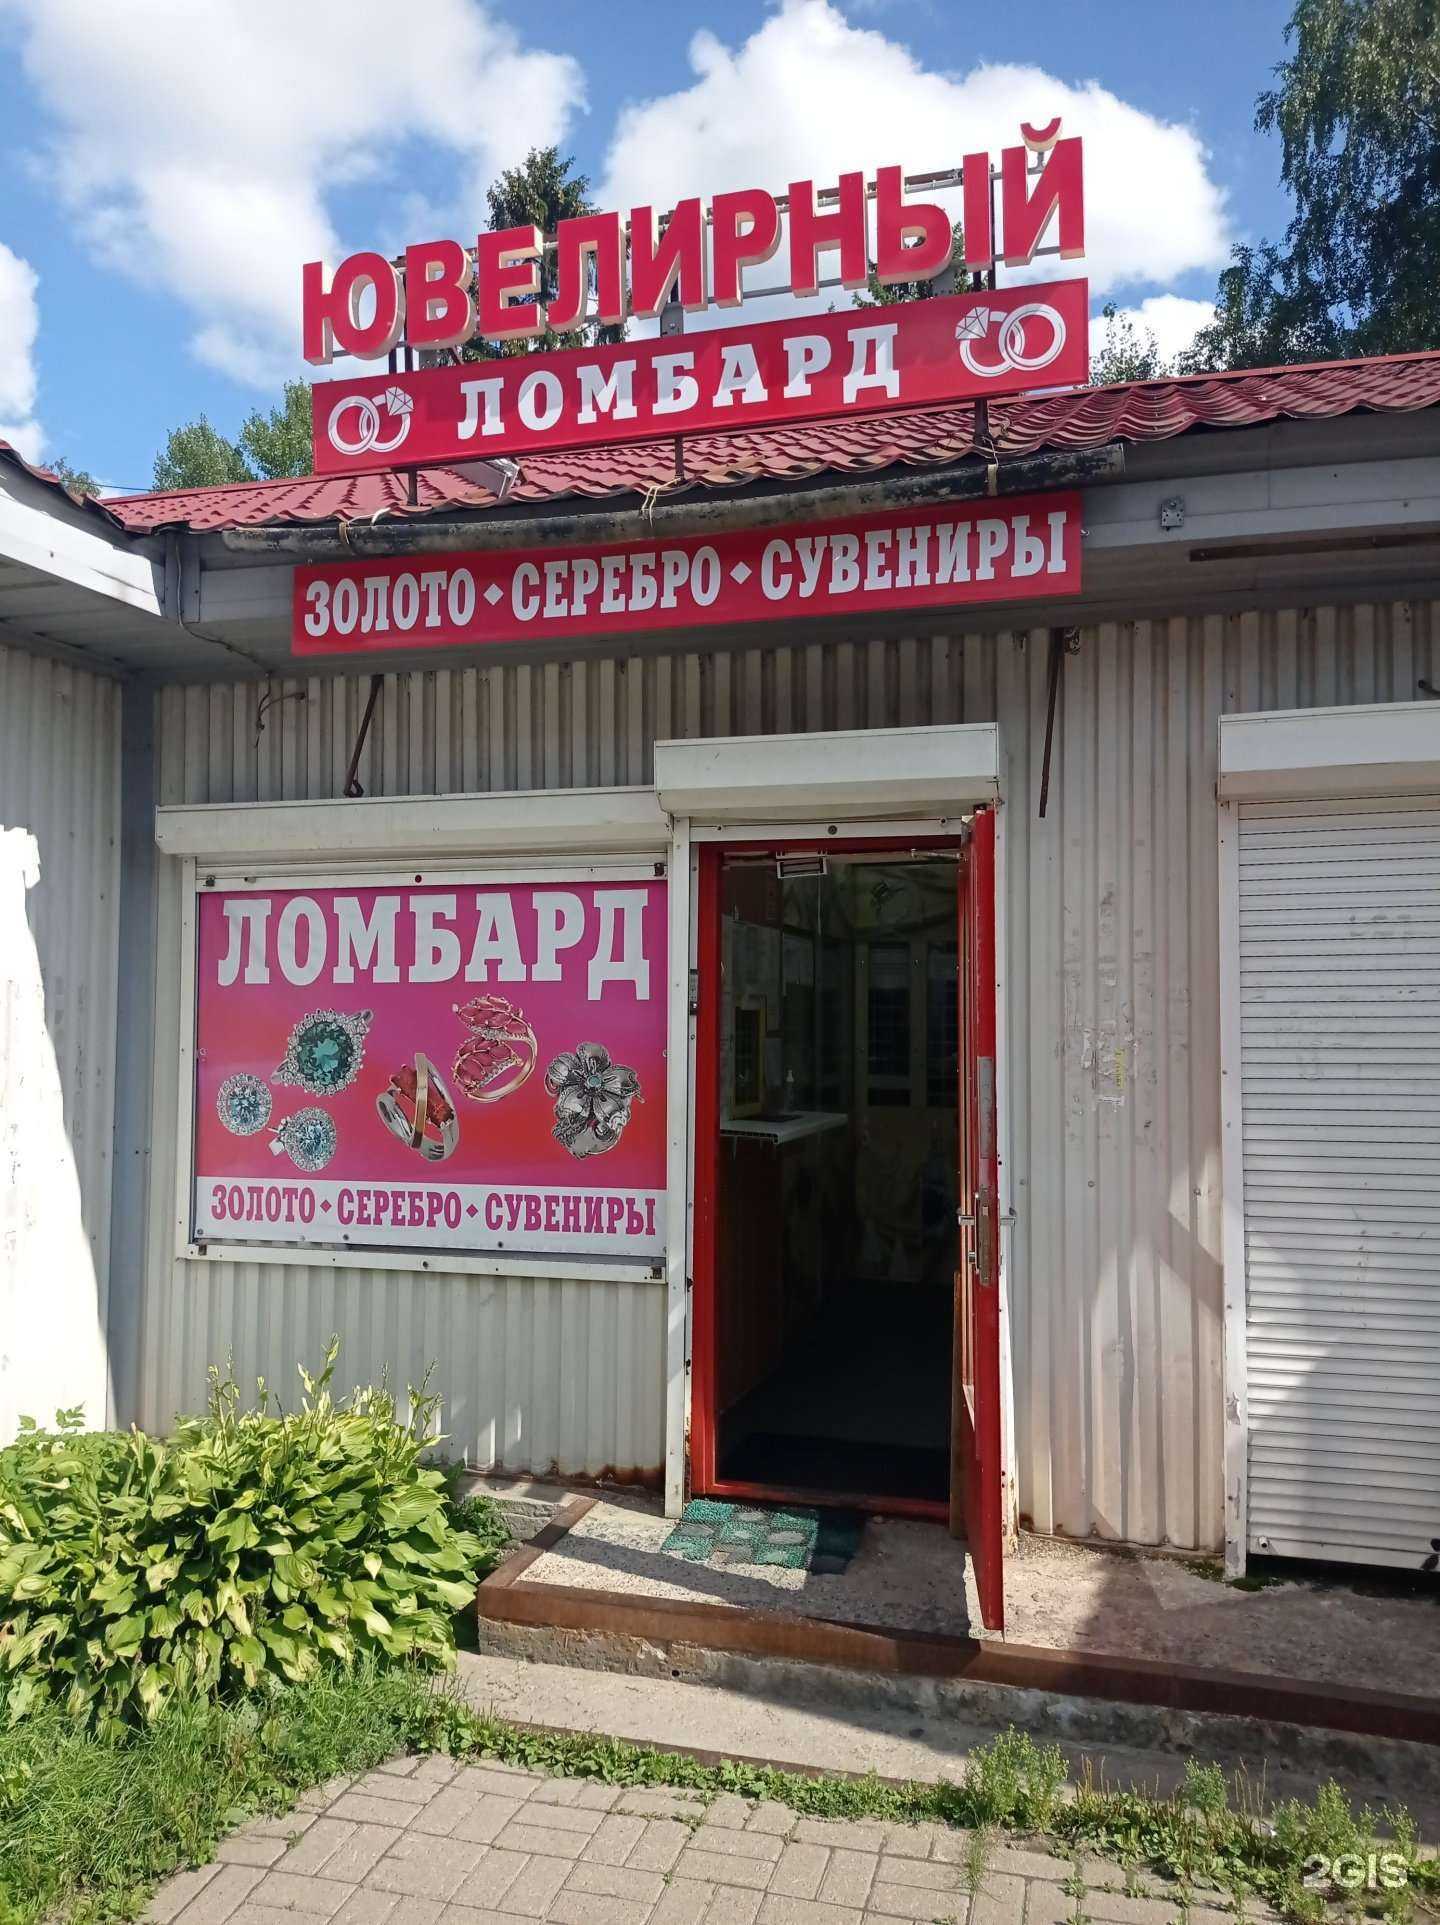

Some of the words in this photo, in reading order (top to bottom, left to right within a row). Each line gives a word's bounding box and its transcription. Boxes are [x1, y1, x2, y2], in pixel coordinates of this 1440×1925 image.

[303, 118, 1085, 365] ЮВЕЛИРНЫЙ
[457, 323, 900, 440] ЛОМБАРД
[304, 569, 477, 637] ЗОЛОТО
[511, 545, 721, 622] СЕРЕБРО
[760, 511, 1067, 600] СУВЕНИРЫ
[217, 889, 650, 1001] ЛОМБАРД
[211, 1184, 316, 1223] ЗОЛОТО
[336, 1188, 462, 1229] СЕРЕБРО
[484, 1193, 656, 1236] СУВЕНИРЫ
